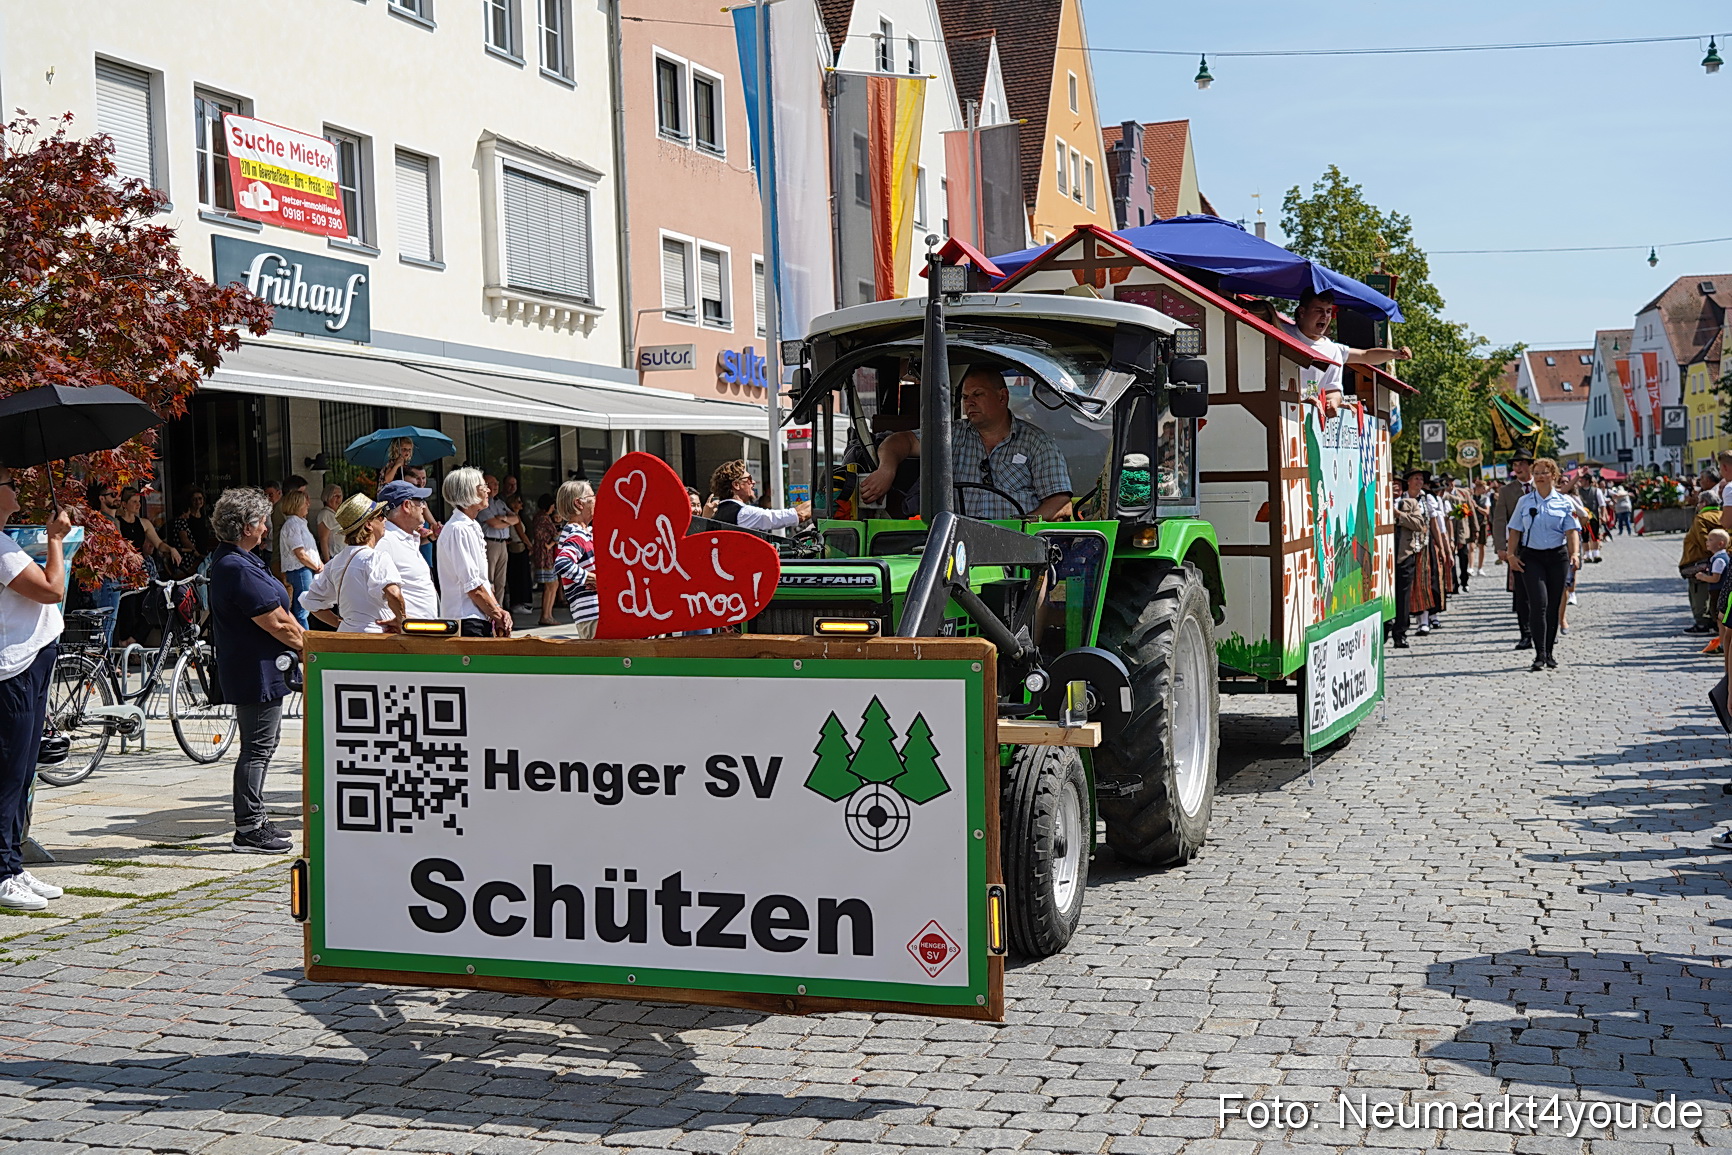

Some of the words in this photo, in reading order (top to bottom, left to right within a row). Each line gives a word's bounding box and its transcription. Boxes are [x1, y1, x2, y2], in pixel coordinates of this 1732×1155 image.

[231, 126, 285, 158] Suche
[289, 140, 335, 173] Mieter!
[282, 206, 305, 222] 09181
[311, 212, 327, 227] 509
[328, 215, 343, 230] 390
[1646, 375, 1661, 409] SALE
[609, 514, 692, 581] weil
[711, 537, 735, 581] i
[618, 570, 673, 620] di
[777, 575, 874, 585] UTZ-FAHR
[485, 748, 687, 806] Henger
[705, 754, 784, 799] SV
[408, 857, 874, 957] Schützen
[920, 942, 946, 950] HENGER
[926, 951, 940, 960] SV
